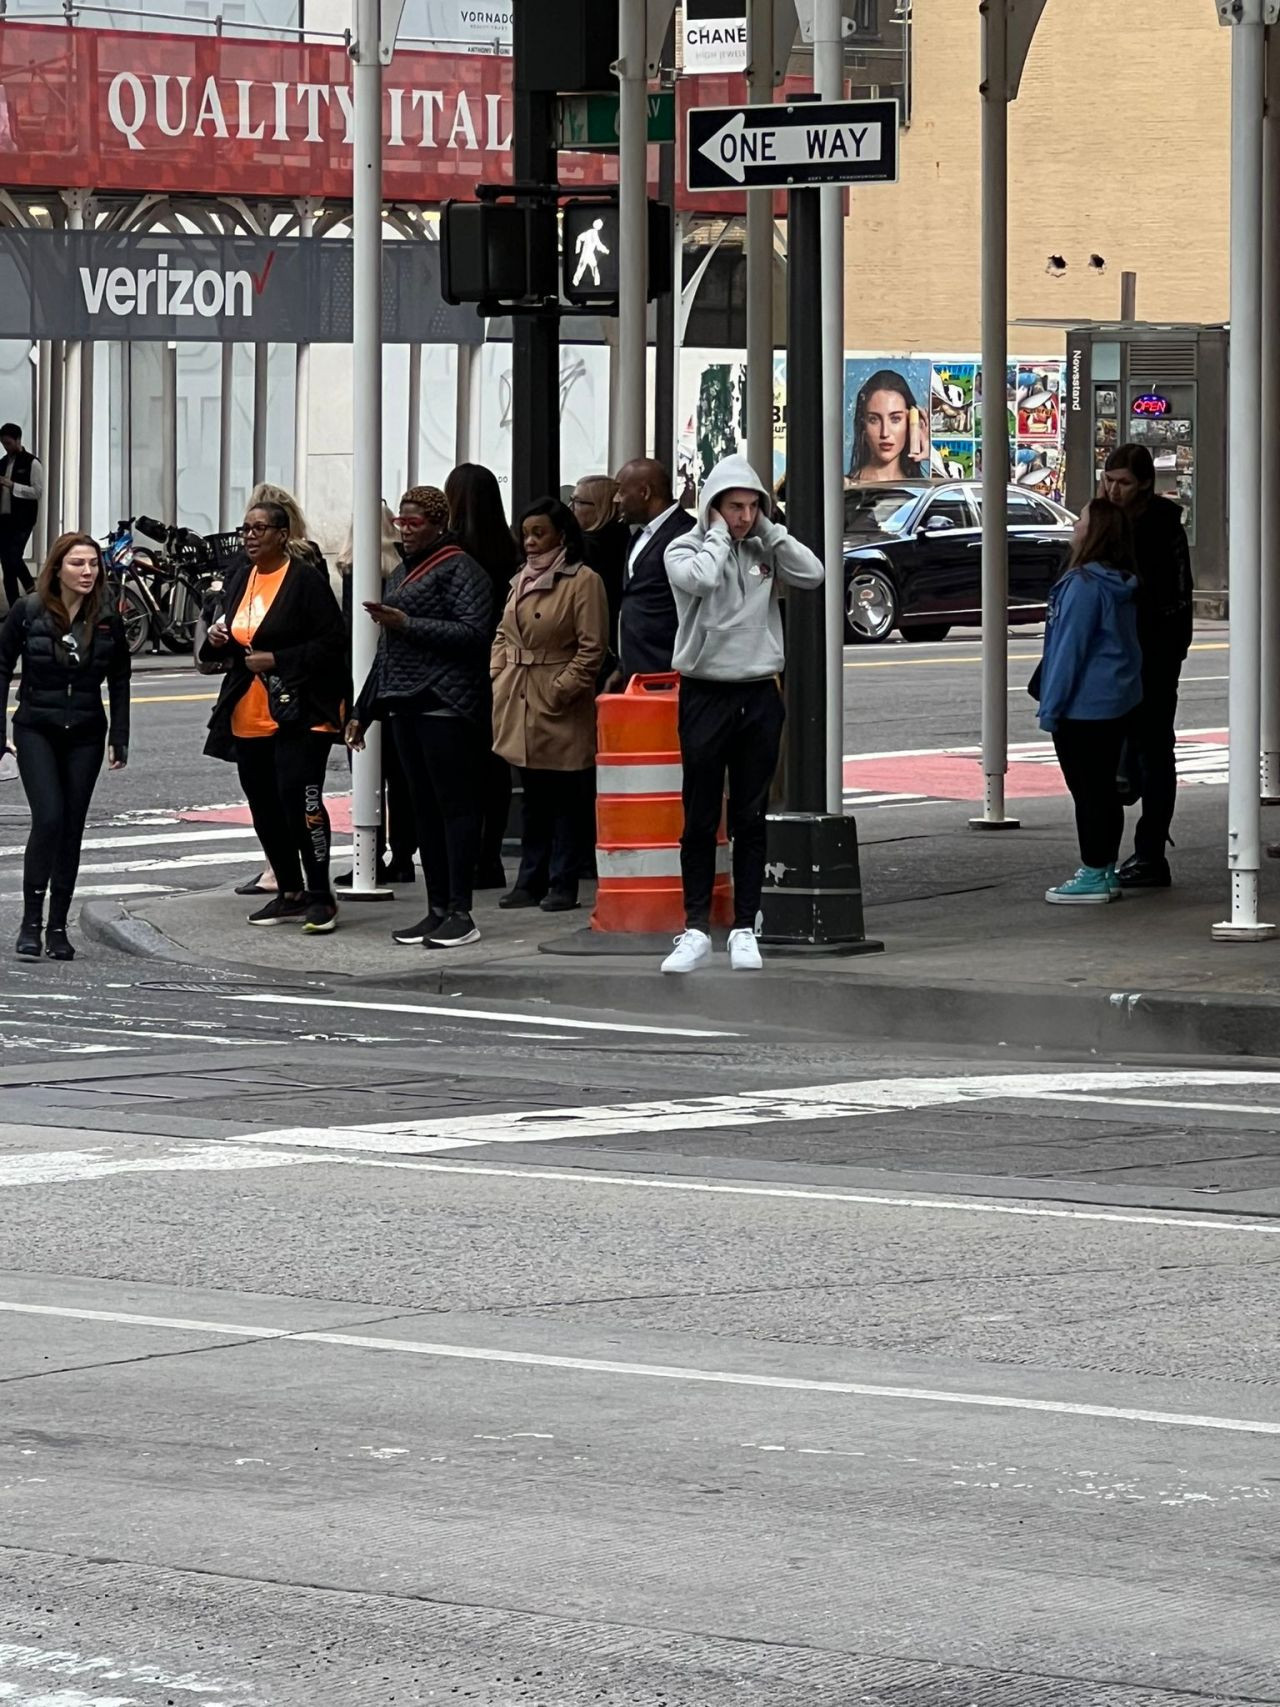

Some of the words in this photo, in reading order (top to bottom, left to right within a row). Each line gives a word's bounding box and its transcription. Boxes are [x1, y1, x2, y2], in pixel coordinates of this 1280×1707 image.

[107, 71, 354, 150] QUALITY
[387, 88, 513, 152] ITAL
[720, 132, 777, 164] ONE
[806, 127, 869, 159] WAY
[79, 253, 253, 318] verizon
[1133, 399, 1166, 414] OPEN
[305, 784, 320, 812] LOUIS
